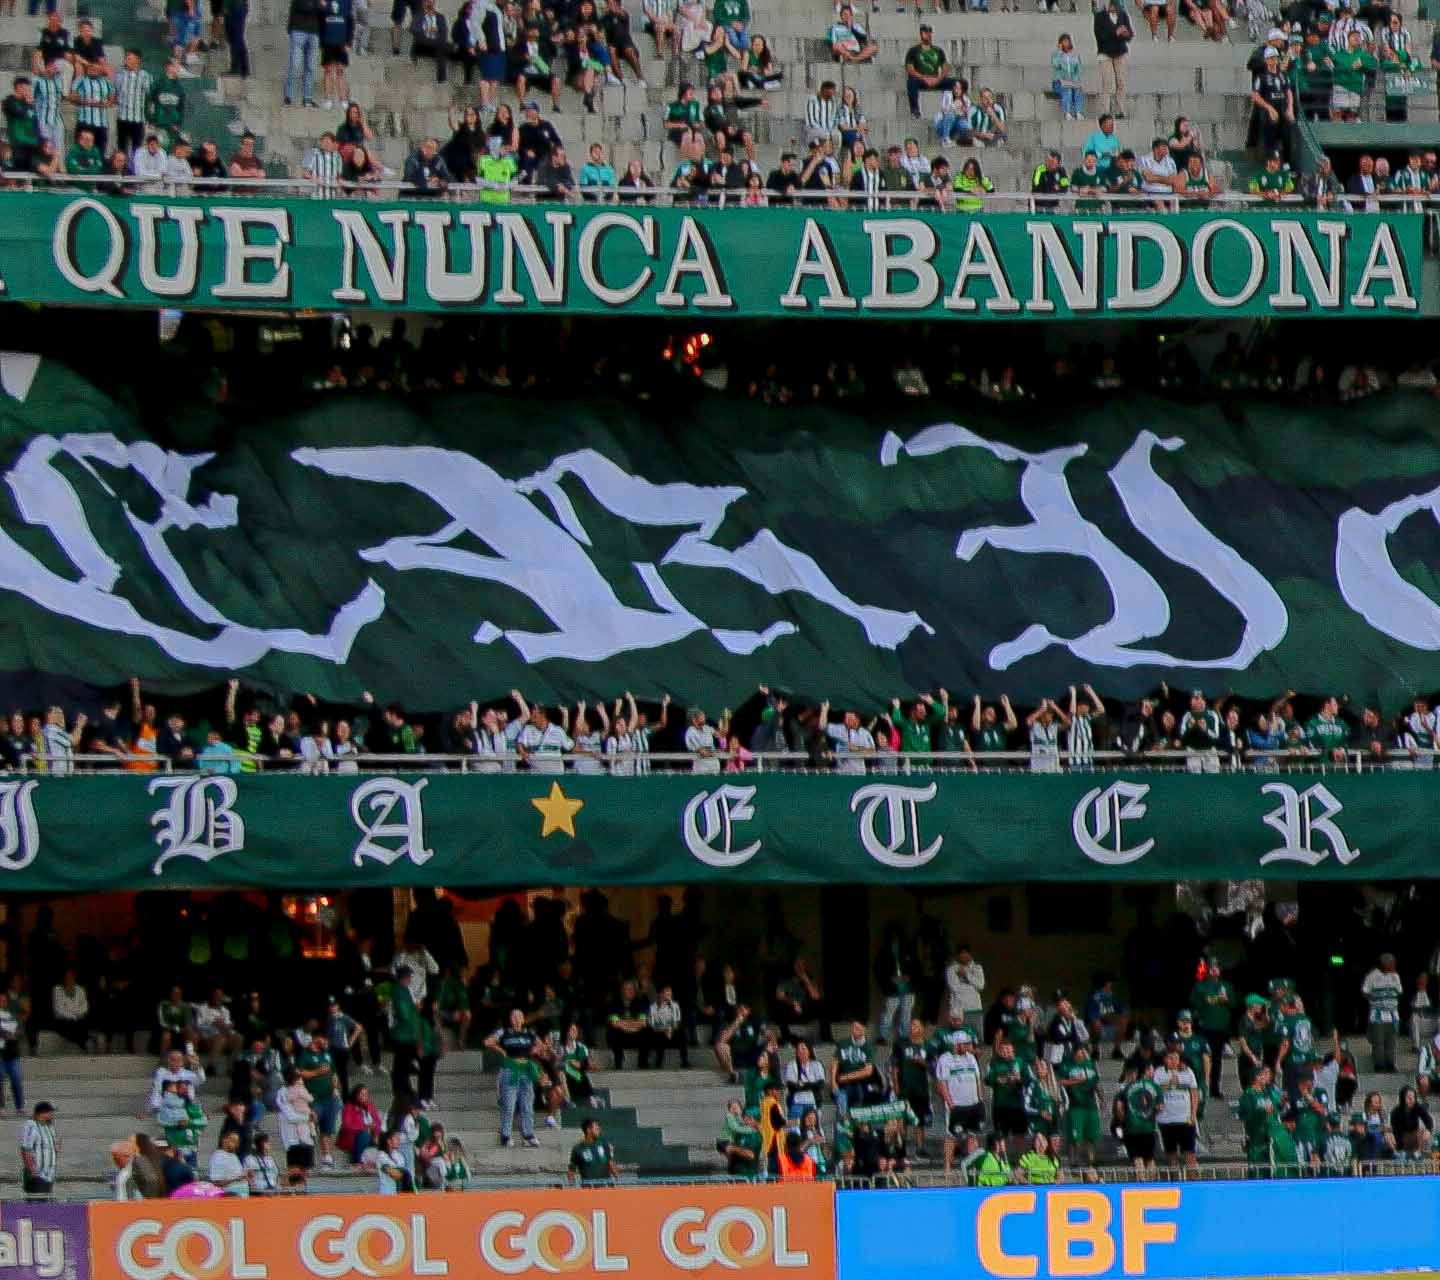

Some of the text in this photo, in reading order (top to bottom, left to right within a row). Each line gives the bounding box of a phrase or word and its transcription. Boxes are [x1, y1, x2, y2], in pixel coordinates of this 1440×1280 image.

[51, 197, 294, 300] QUE
[331, 210, 735, 309] NUNCA
[780, 217, 1418, 313] ABANDONA
[299, 1213, 449, 1280] GOL
[479, 1209, 629, 1276] GOL
[660, 1205, 810, 1272] GOL
[974, 1187, 1182, 1278] CBF
